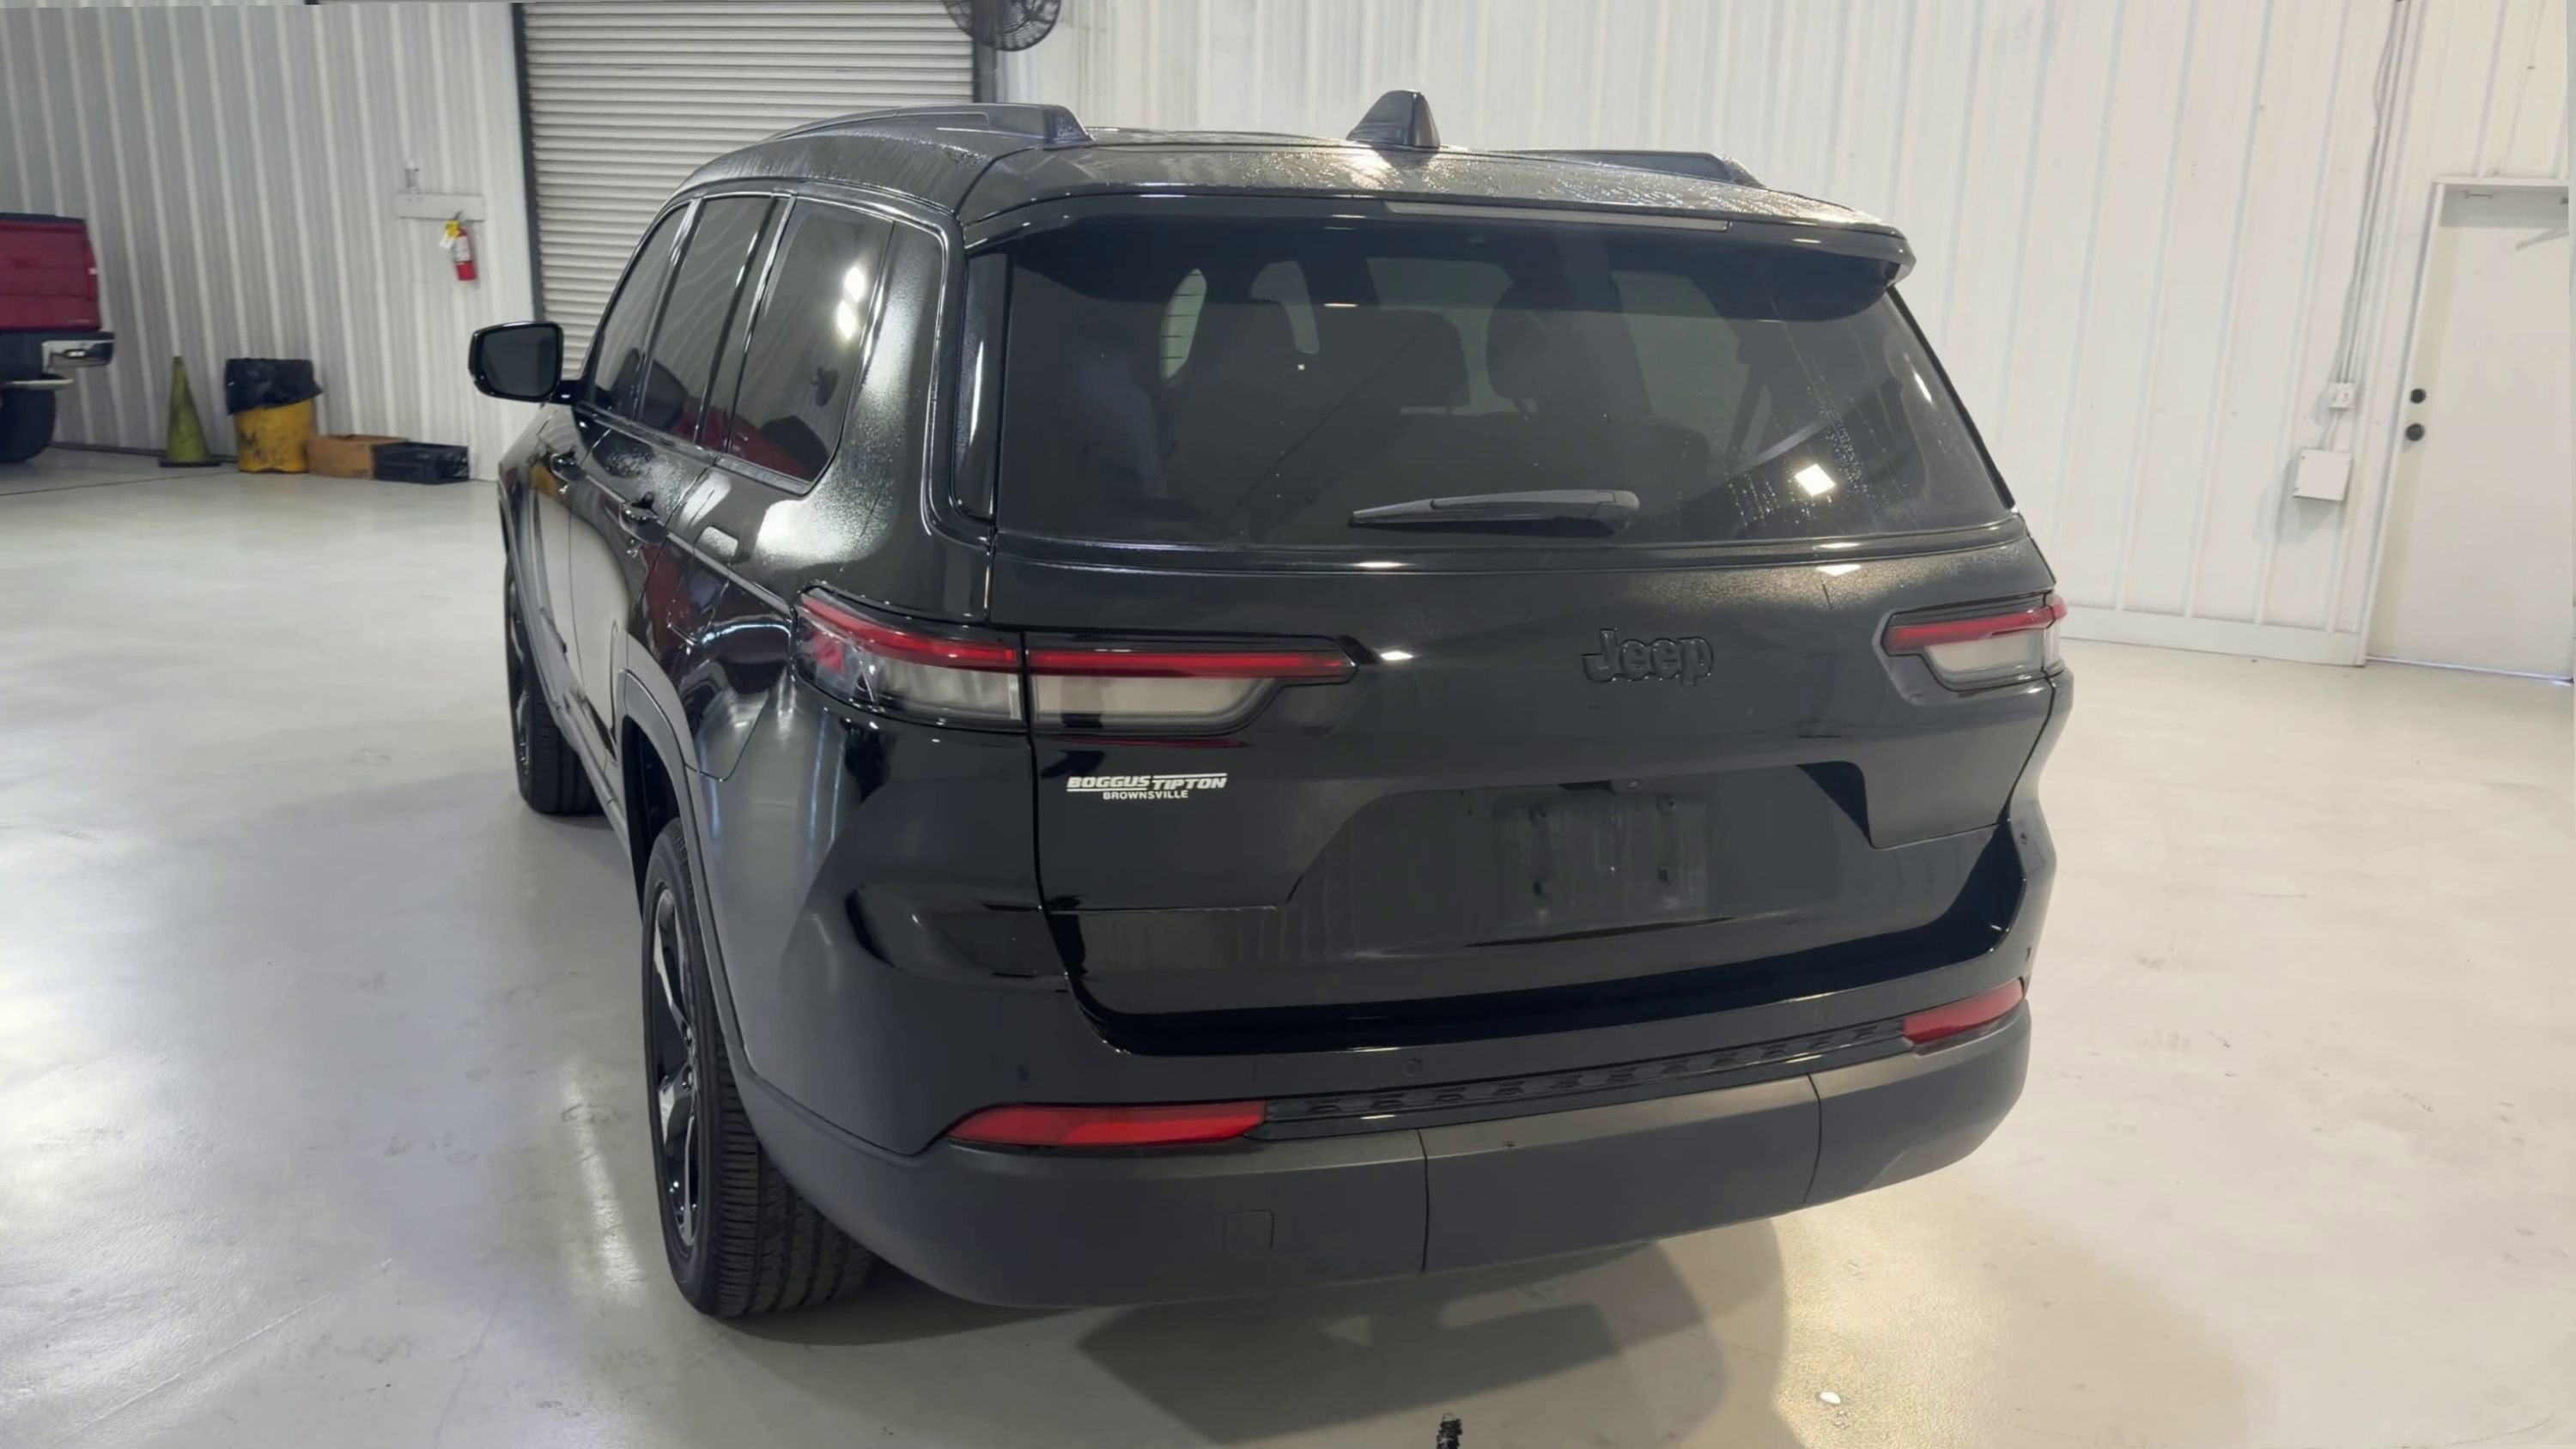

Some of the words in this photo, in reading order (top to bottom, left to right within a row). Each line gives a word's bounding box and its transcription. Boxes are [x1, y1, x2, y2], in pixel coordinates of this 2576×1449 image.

[1582, 628, 1714, 687] Jeep
[1067, 776, 1151, 788] BOGGUS
[1152, 778, 1227, 790] TIPTON
[1103, 791, 1188, 800] BROWNSVILLE
